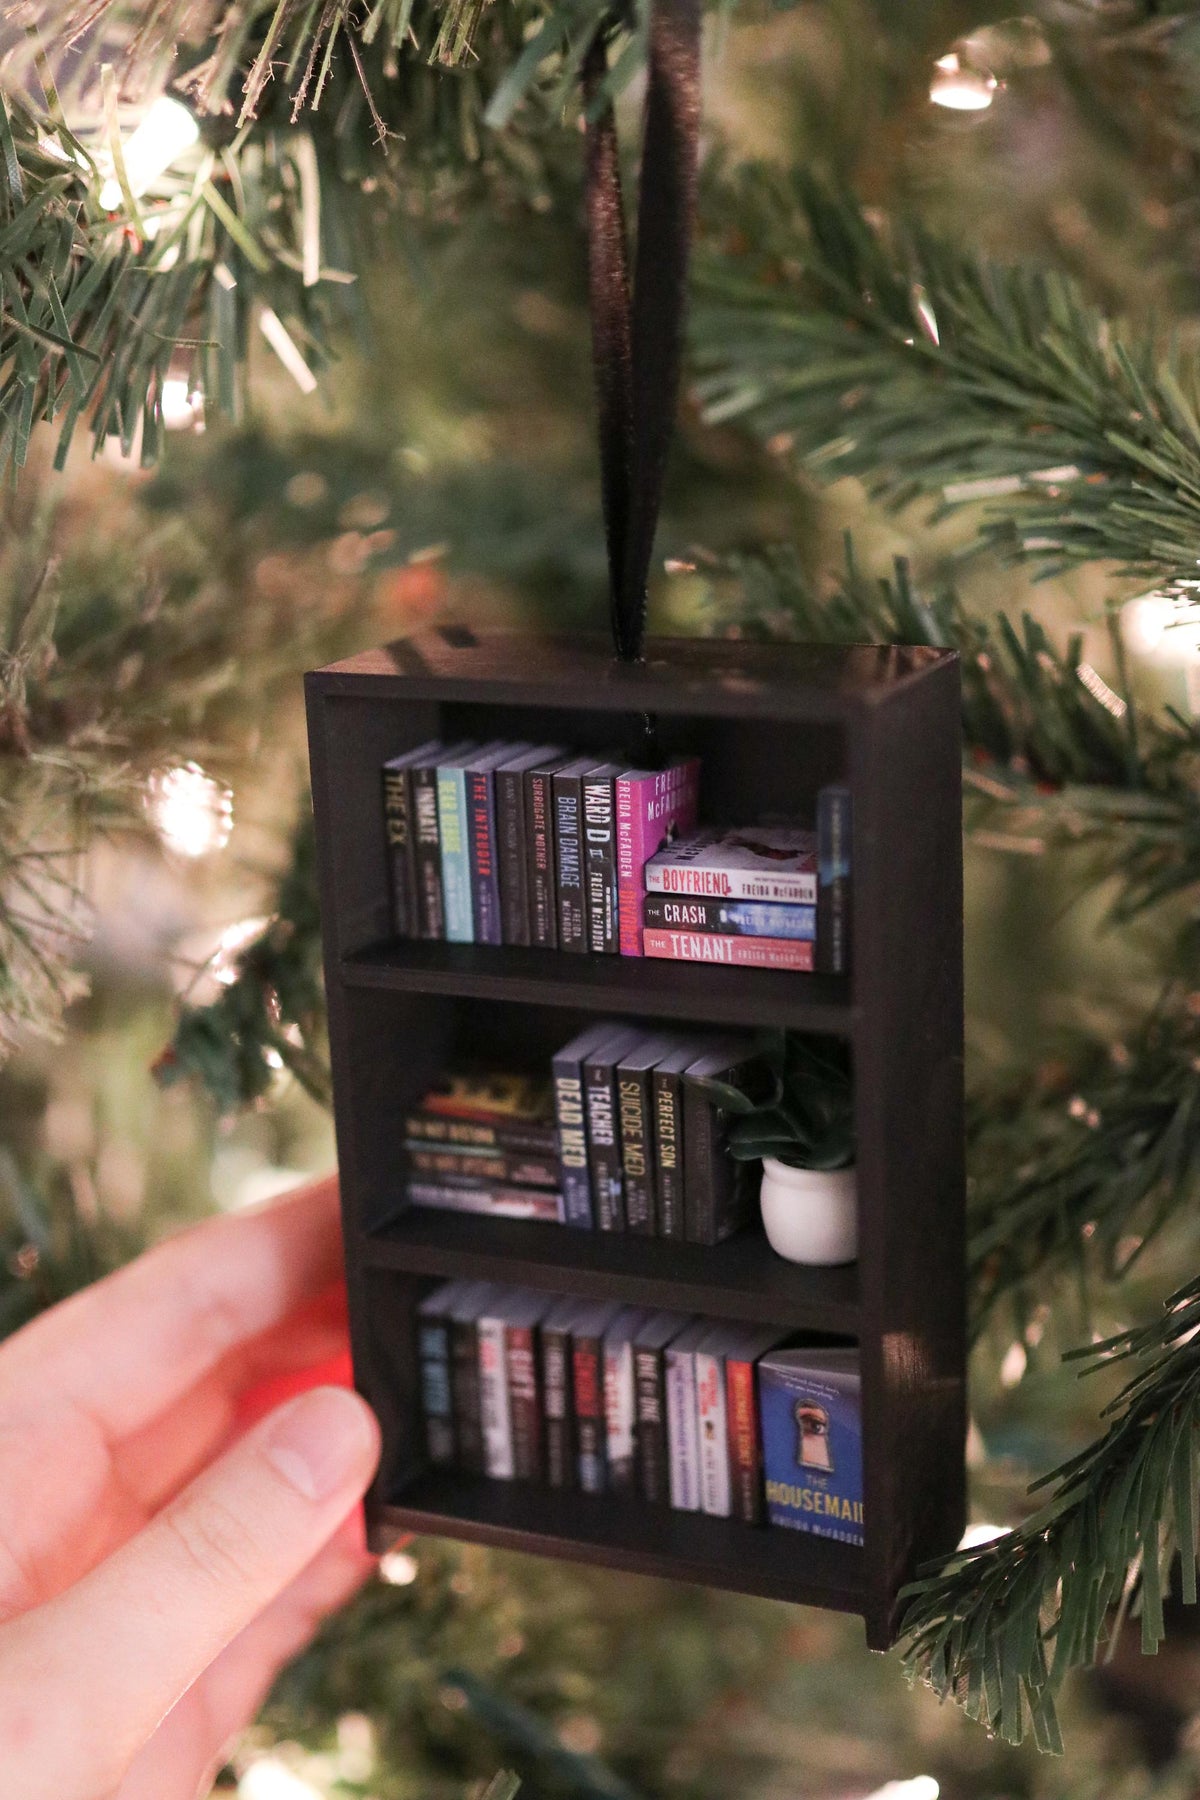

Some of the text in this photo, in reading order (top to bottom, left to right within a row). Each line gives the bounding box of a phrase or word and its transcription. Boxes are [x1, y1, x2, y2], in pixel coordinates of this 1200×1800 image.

[473, 777, 487, 800] THE
[584, 784, 611, 843] WARD D
[619, 780, 631, 818] FREIDA
[416, 787, 438, 844] INMATE
[532, 778, 547, 870] SURROGATE MOTHER
[475, 808, 491, 876] INTRUDER
[557, 796, 580, 888] BRAIN DAMAGE
[619, 822, 633, 878] McFADDEN
[663, 868, 730, 897] BOYFRIEND
[591, 872, 604, 951] FREIDA McFADDEN
[664, 904, 706, 925] CRASH
[651, 940, 666, 949] THE
[671, 934, 734, 962] TENANT
[556, 1078, 583, 1125] DEAD
[589, 1086, 614, 1146] TEACHER
[658, 1090, 675, 1142] PERFECT
[560, 1129, 587, 1167] MED
[619, 1081, 646, 1176] SUICIDE MED
[660, 1144, 676, 1169] SON
[807, 1475, 828, 1487] THE
